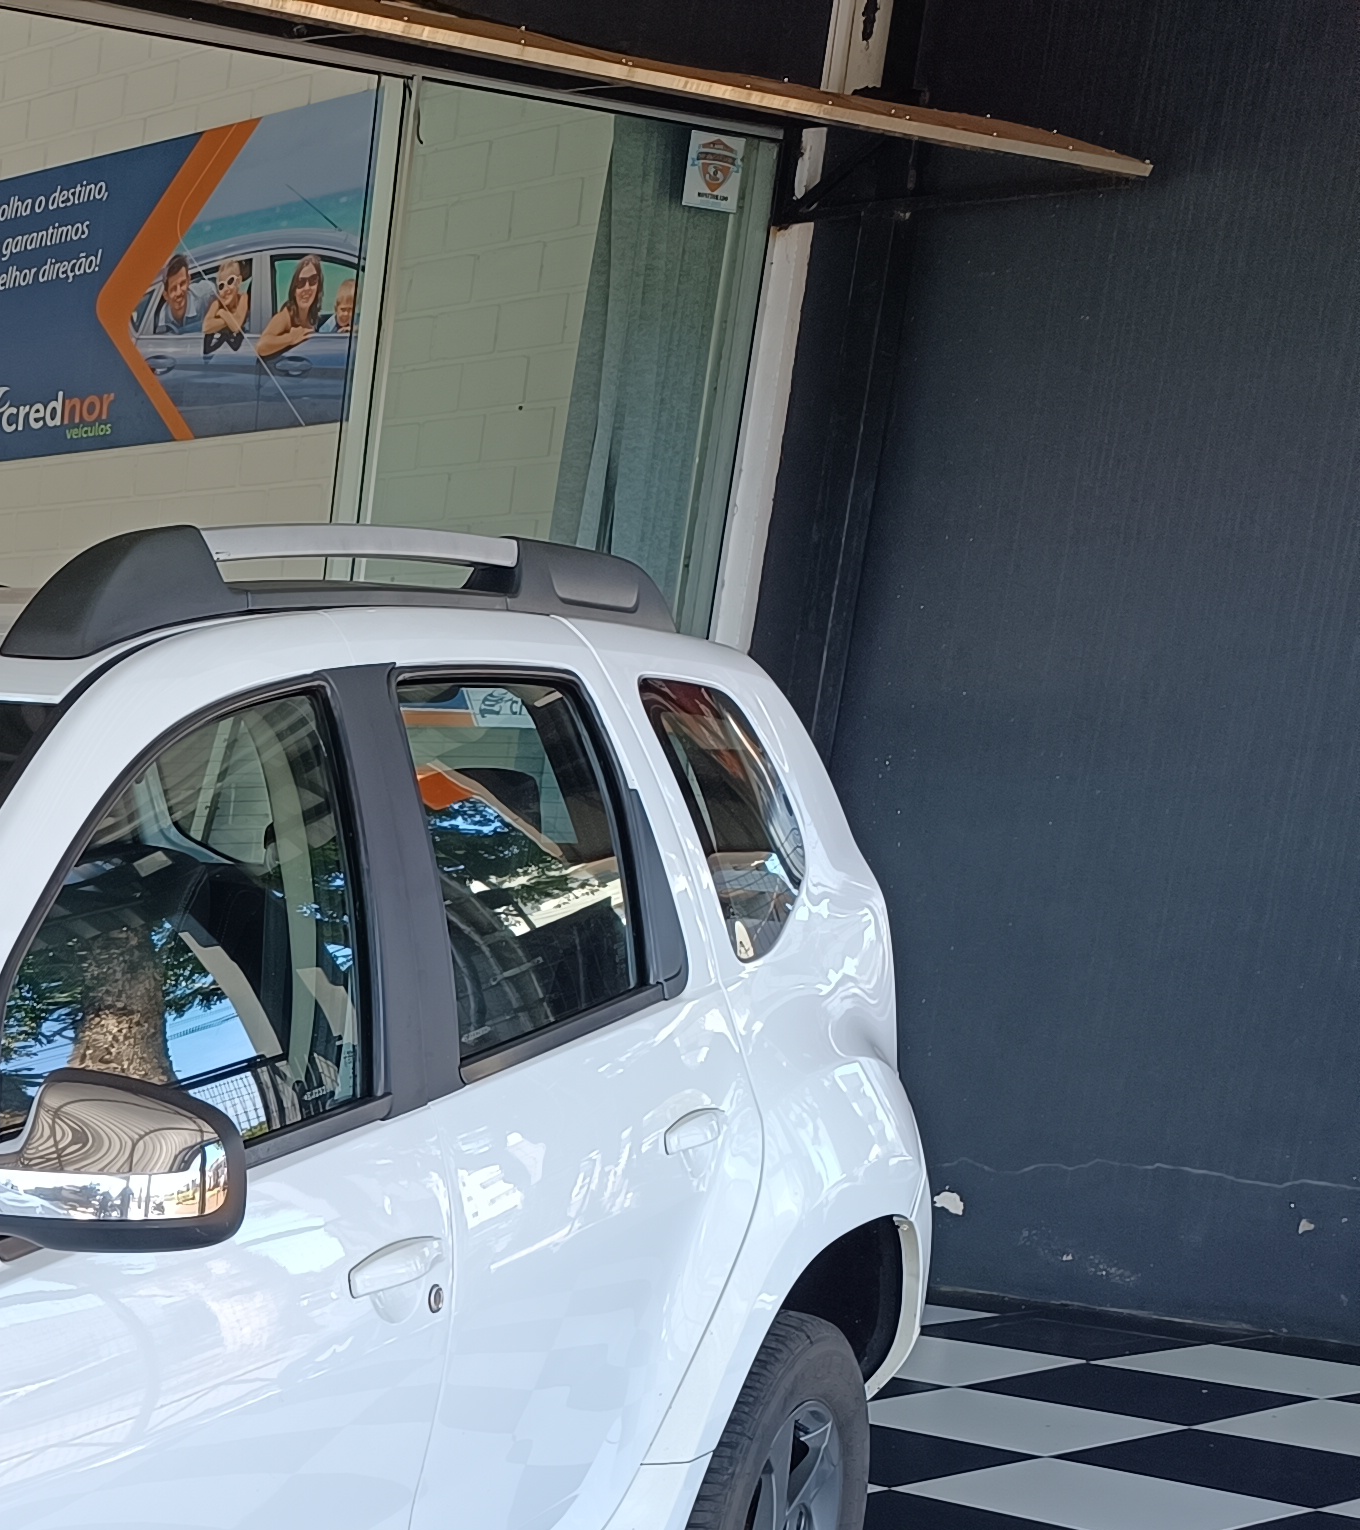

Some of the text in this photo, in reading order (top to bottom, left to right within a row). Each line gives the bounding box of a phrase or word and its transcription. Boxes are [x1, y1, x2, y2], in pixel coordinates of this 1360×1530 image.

[34, 194, 46, 214] o
[49, 179, 109, 211] destino,
[2, 219, 90, 260] garantimos
[38, 249, 103, 285] direção!
[2, 391, 115, 434] crednor
[65, 421, 112, 440] veículos
